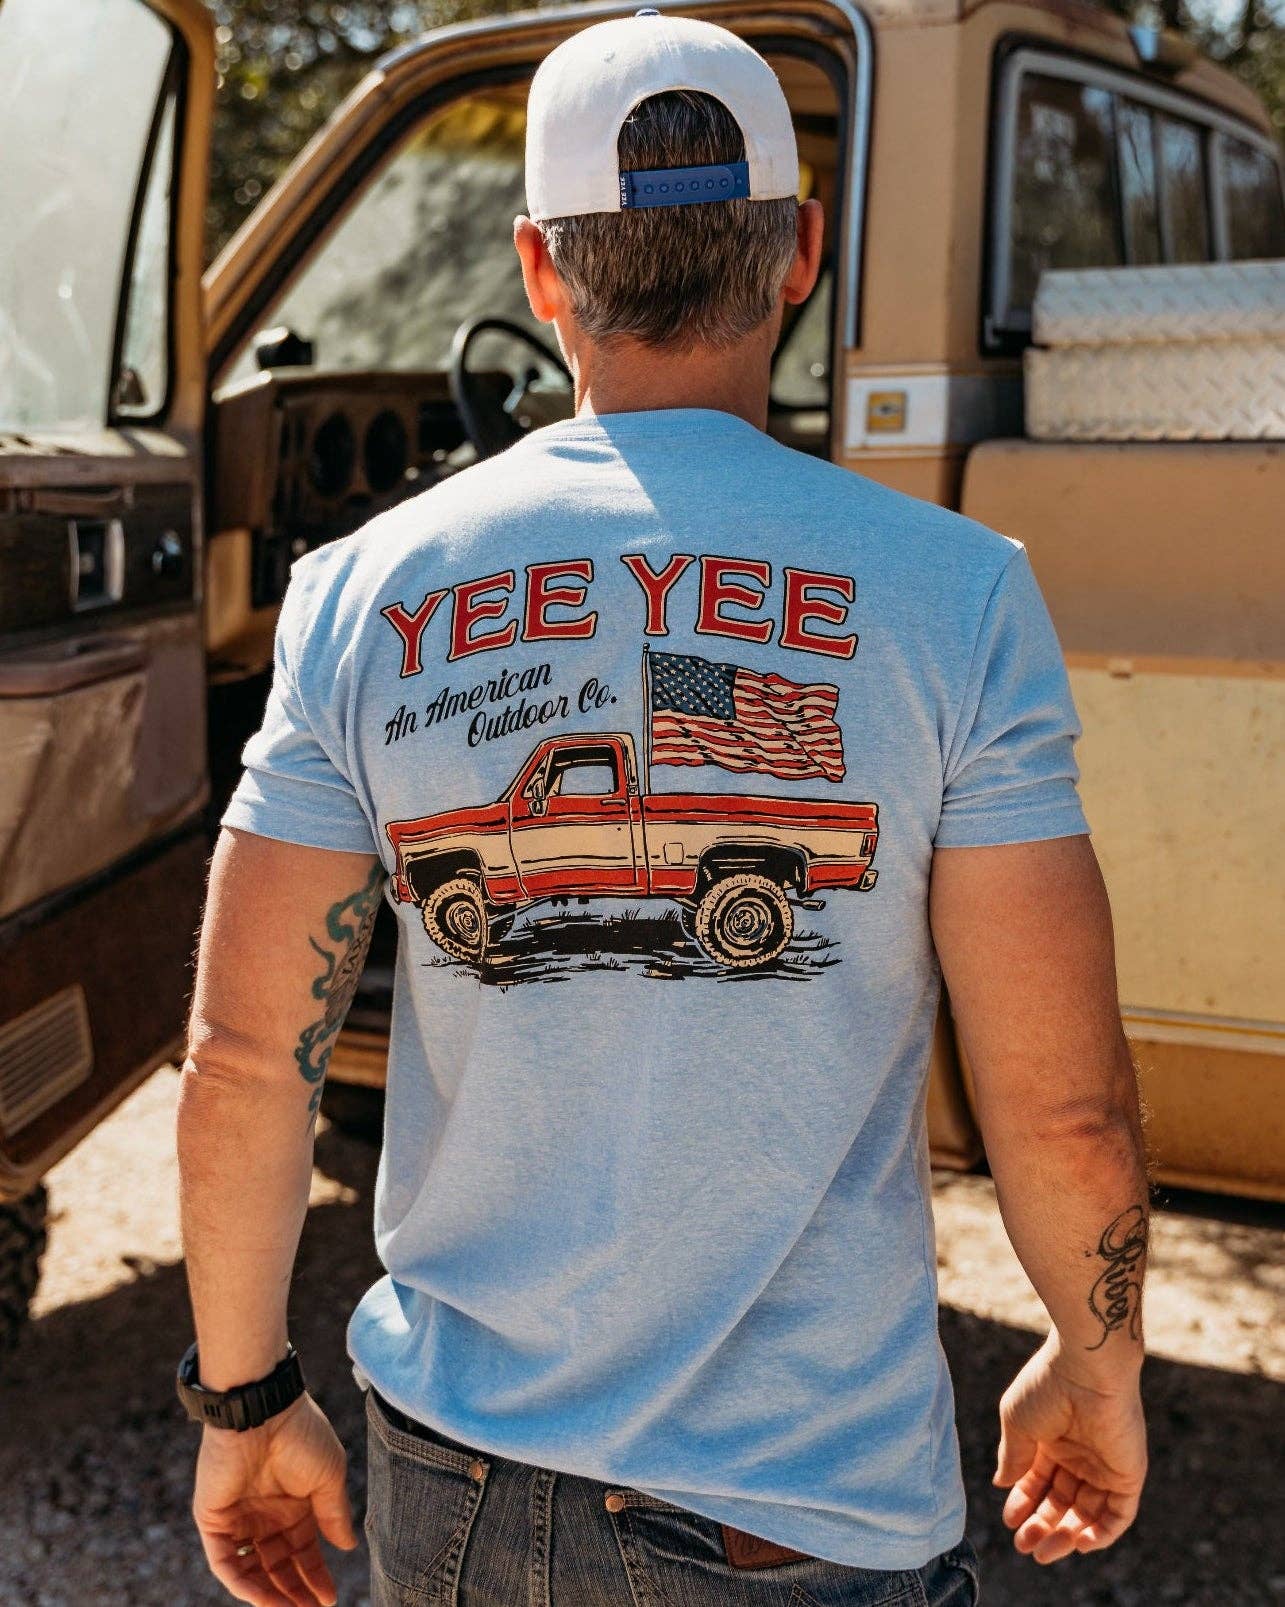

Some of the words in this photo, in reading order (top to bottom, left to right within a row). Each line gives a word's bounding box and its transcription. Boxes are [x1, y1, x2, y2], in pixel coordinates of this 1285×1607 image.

[380, 558, 598, 679] YEE
[620, 553, 858, 660] YEE
[385, 704, 418, 746] An
[425, 663, 553, 728] American
[467, 695, 570, 748] Outdoor
[578, 677, 618, 714] Co.
